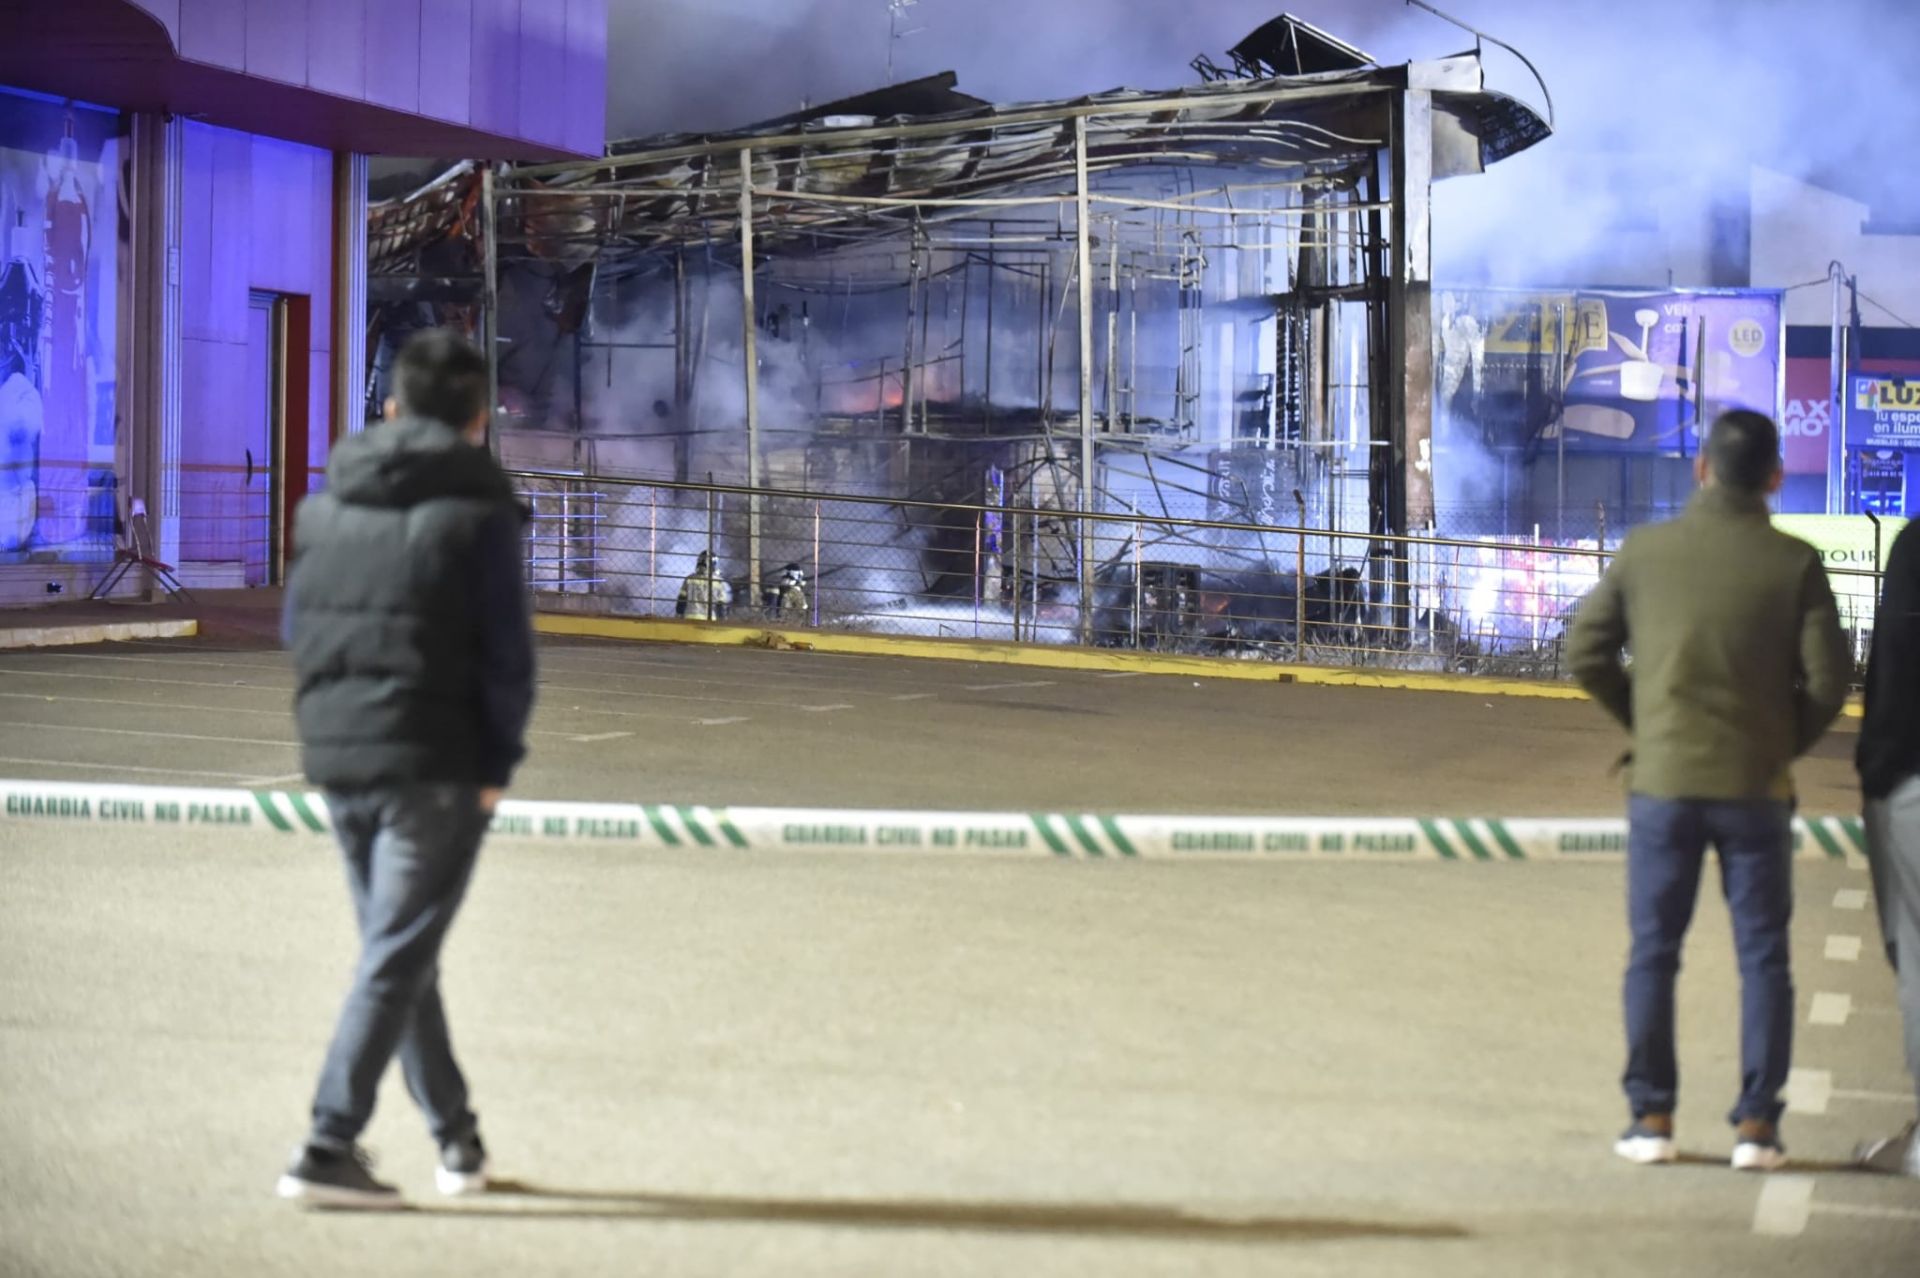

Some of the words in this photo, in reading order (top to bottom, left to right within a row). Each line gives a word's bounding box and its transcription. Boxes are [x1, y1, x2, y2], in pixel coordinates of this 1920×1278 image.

[1733, 328, 1763, 342] LED
[1880, 386, 1920, 405] LU
[1873, 422, 1890, 433] en
[6, 793, 92, 819] GUARDIA
[99, 799, 145, 820] CIVIL
[154, 802, 180, 822] NO
[188, 803, 251, 824] PASAR
[577, 818, 640, 838] PASAR
[784, 824, 867, 845] GUARDIA
[964, 828, 1028, 849] PASAR
[1559, 832, 1628, 852] GUARD
